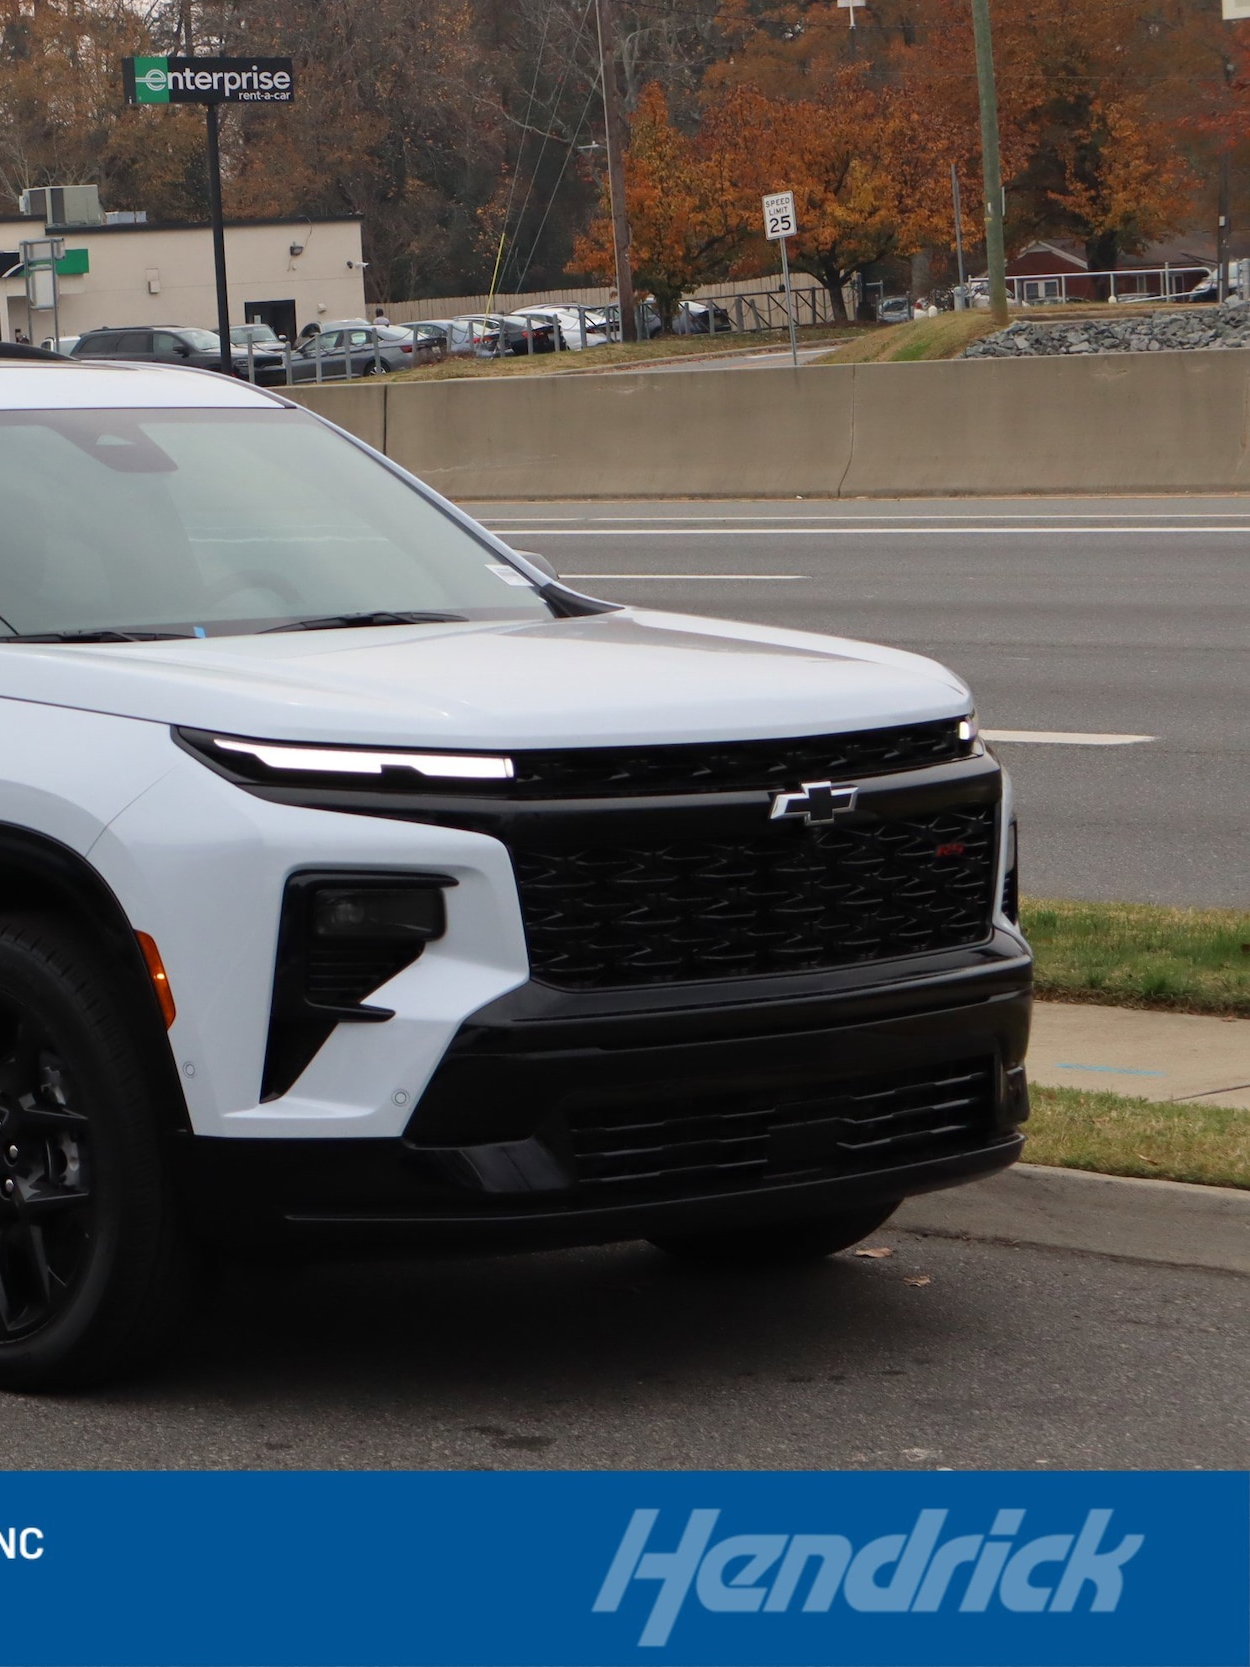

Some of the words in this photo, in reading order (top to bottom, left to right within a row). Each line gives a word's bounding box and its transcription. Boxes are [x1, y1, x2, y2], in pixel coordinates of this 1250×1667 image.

[135, 65, 291, 97] enterprise
[238, 92, 291, 101] rent-a-car
[766, 197, 790, 208] SPEED
[769, 207, 788, 216] LIMIT
[770, 215, 791, 233] 25
